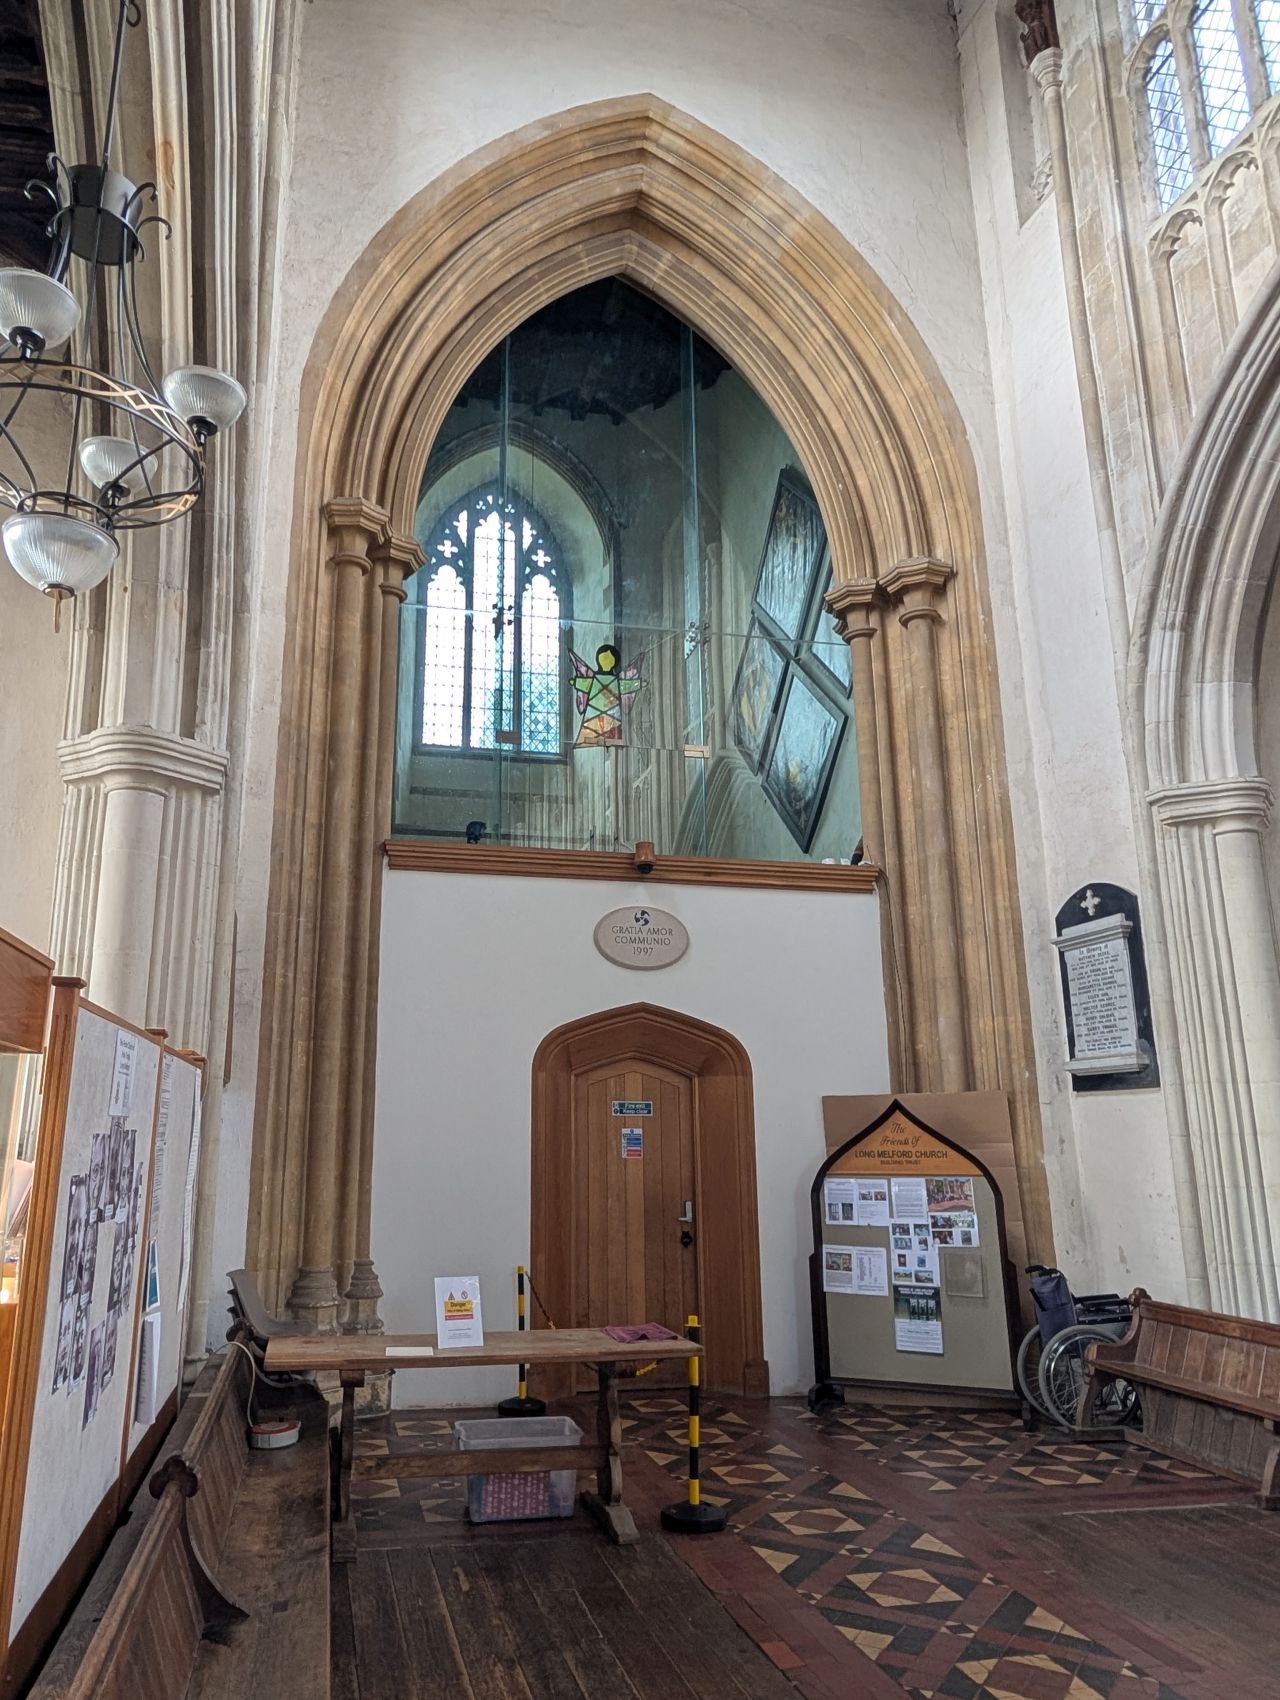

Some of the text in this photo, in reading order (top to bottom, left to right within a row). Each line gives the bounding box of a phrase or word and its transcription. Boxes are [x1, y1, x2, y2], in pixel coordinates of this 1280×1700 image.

[611, 926, 674, 936] GRATIA AMOR
[614, 936, 671, 946] COMMUNIO
[632, 946, 654, 956] 1997
[890, 1121, 906, 1134] The
[880, 1135, 922, 1148] Friends Of
[854, 1150, 948, 1159] LONG MELFORD CHURCH
